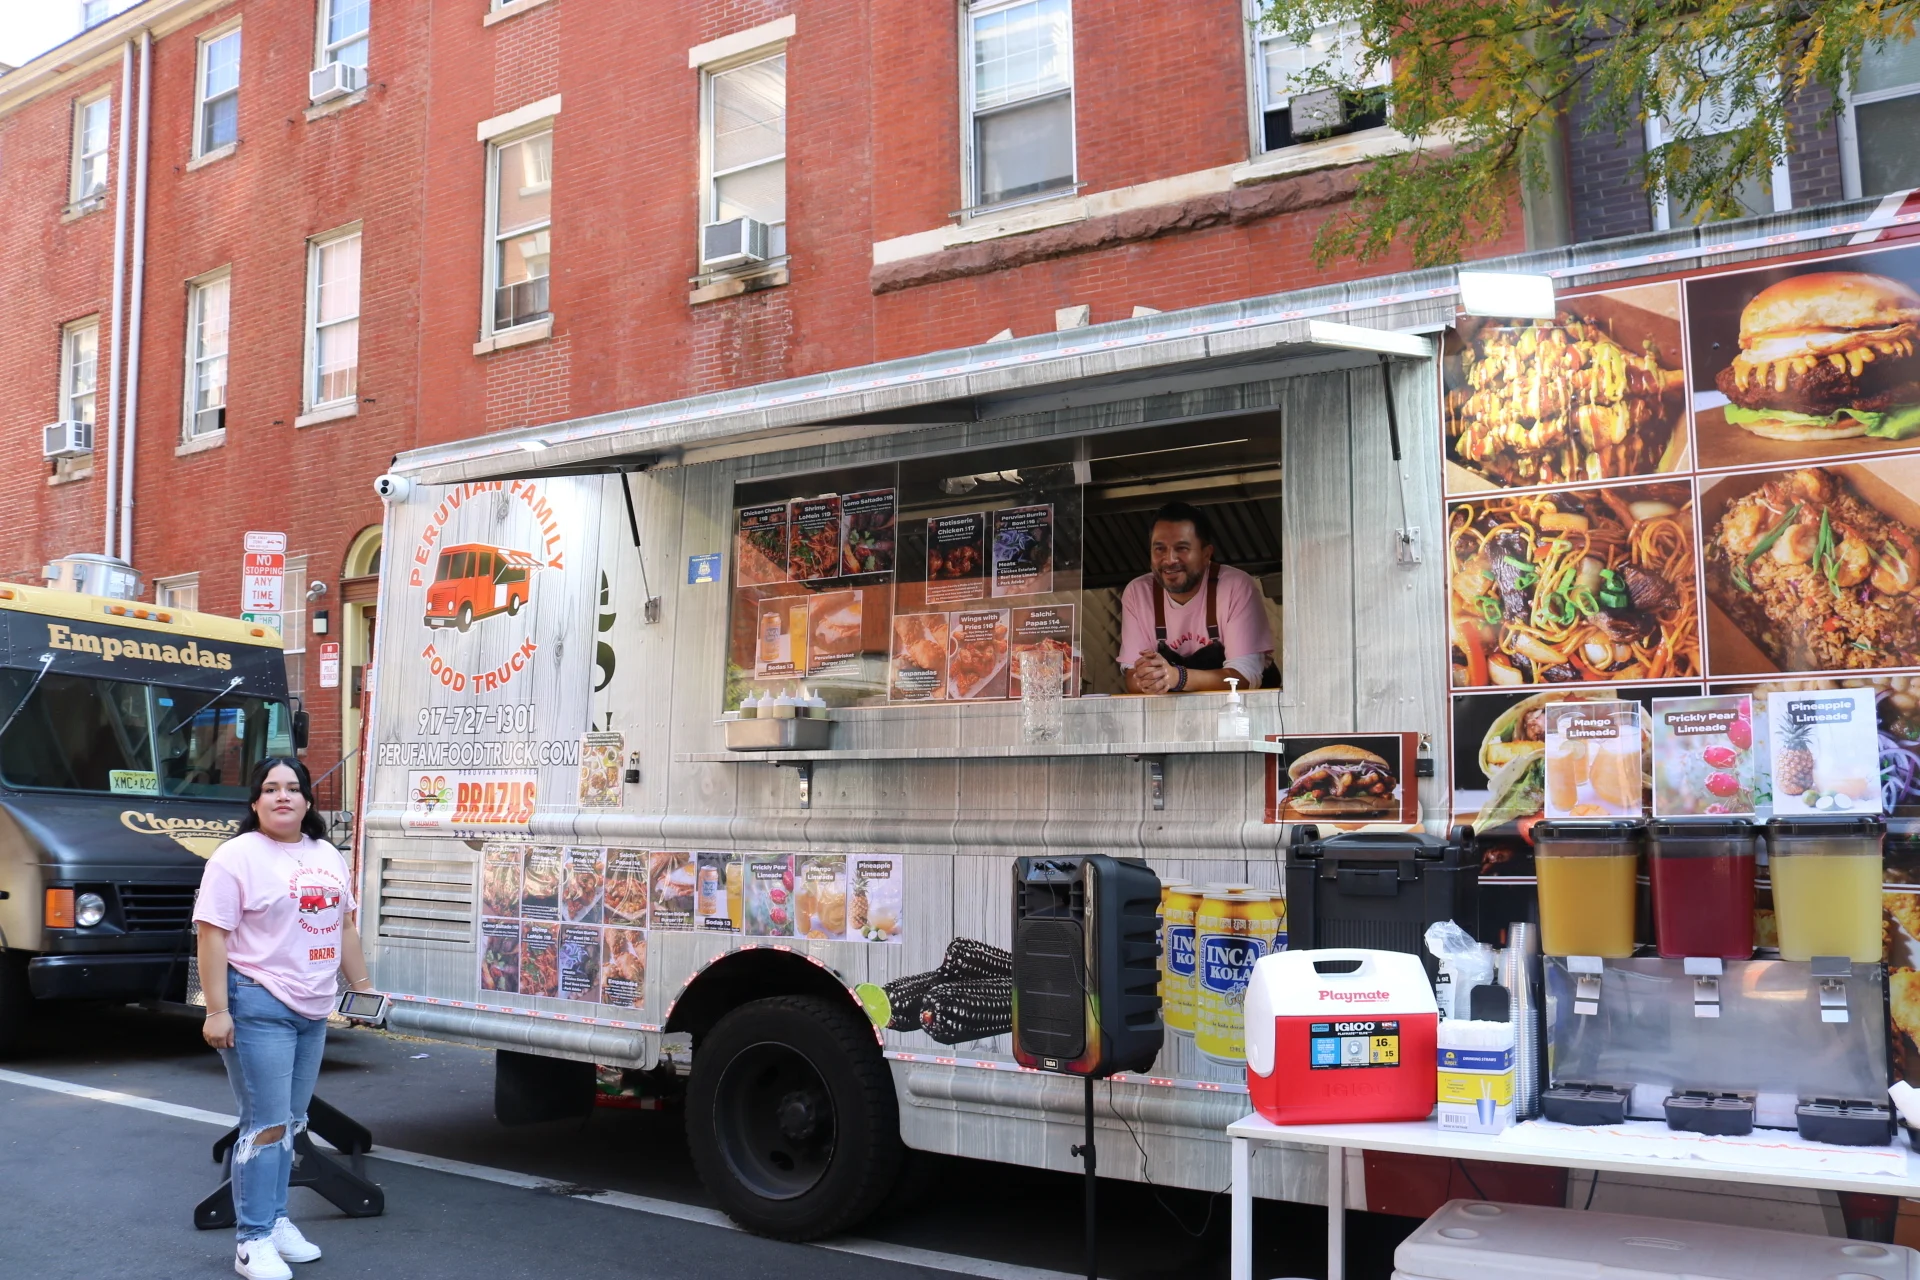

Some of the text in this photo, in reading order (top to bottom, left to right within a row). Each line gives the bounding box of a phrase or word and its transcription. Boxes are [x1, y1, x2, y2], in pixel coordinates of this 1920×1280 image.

[743, 509, 764, 517] Chicken
[1001, 513, 1026, 521] Peruvian
[939, 517, 973, 527] Rotisserie
[409, 480, 564, 587] PERUVIAN FAMILY
[937, 526, 964, 535] Chicken
[256, 554, 272, 566] NO
[245, 566, 283, 576] STOPPING
[254, 577, 273, 587] ANY
[252, 590, 273, 600] TIME
[1030, 610, 1056, 618] Salchi-
[47, 623, 232, 671] Empanadas
[421, 636, 538, 694] FOOD TRUCK
[899, 669, 937, 677] Empanadas
[1791, 700, 1852, 712] Pineapple
[418, 704, 535, 735] 917-727-1301
[1667, 712, 1736, 723] Prickly Pear
[1796, 712, 1848, 723] Limeade
[1569, 729, 1617, 737] Limeade
[1677, 723, 1727, 733] Limeade
[378, 740, 580, 767] PERUFAMFOODTRUCK.COM
[500, 768, 538, 776] INSPIRED
[451, 781, 536, 824] BRAZAS
[752, 864, 772, 872] Prickly
[858, 862, 891, 870] Pineapple
[298, 917, 340, 935] FOOD TRUC
[309, 947, 335, 961] BRAZAS
[1176, 951, 1195, 966] KO
[1206, 945, 1257, 966] INCA
[1210, 966, 1252, 980] KOLA
[608, 979, 638, 987] Empanadas
[1318, 990, 1390, 1003] Playmate
[1335, 1022, 1375, 1032] IGLOO
[1376, 1038, 1388, 1047] 16
